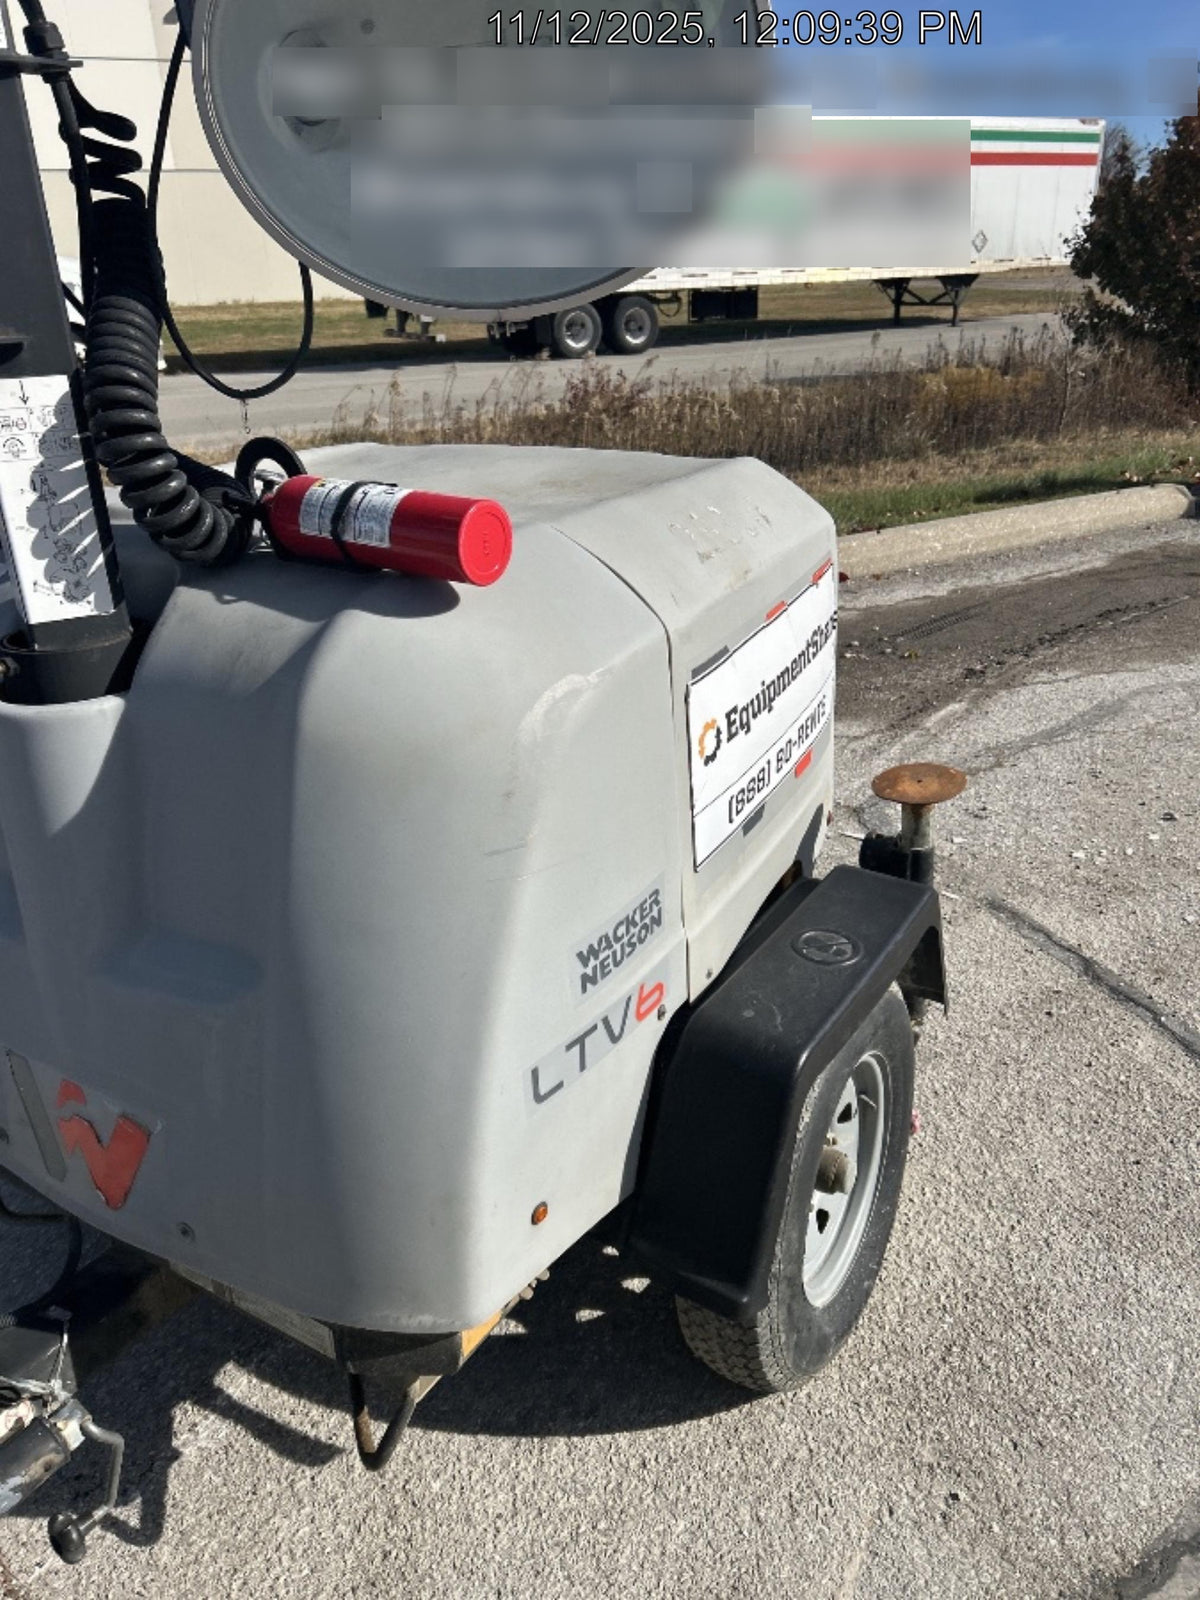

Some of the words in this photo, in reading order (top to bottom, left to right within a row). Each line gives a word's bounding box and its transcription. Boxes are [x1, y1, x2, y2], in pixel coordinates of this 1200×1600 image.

[728, 759, 771, 824] (888)
[576, 888, 661, 969] WACKER
[580, 907, 663, 994] NEUSON
[531, 982, 665, 1105] LTV6
